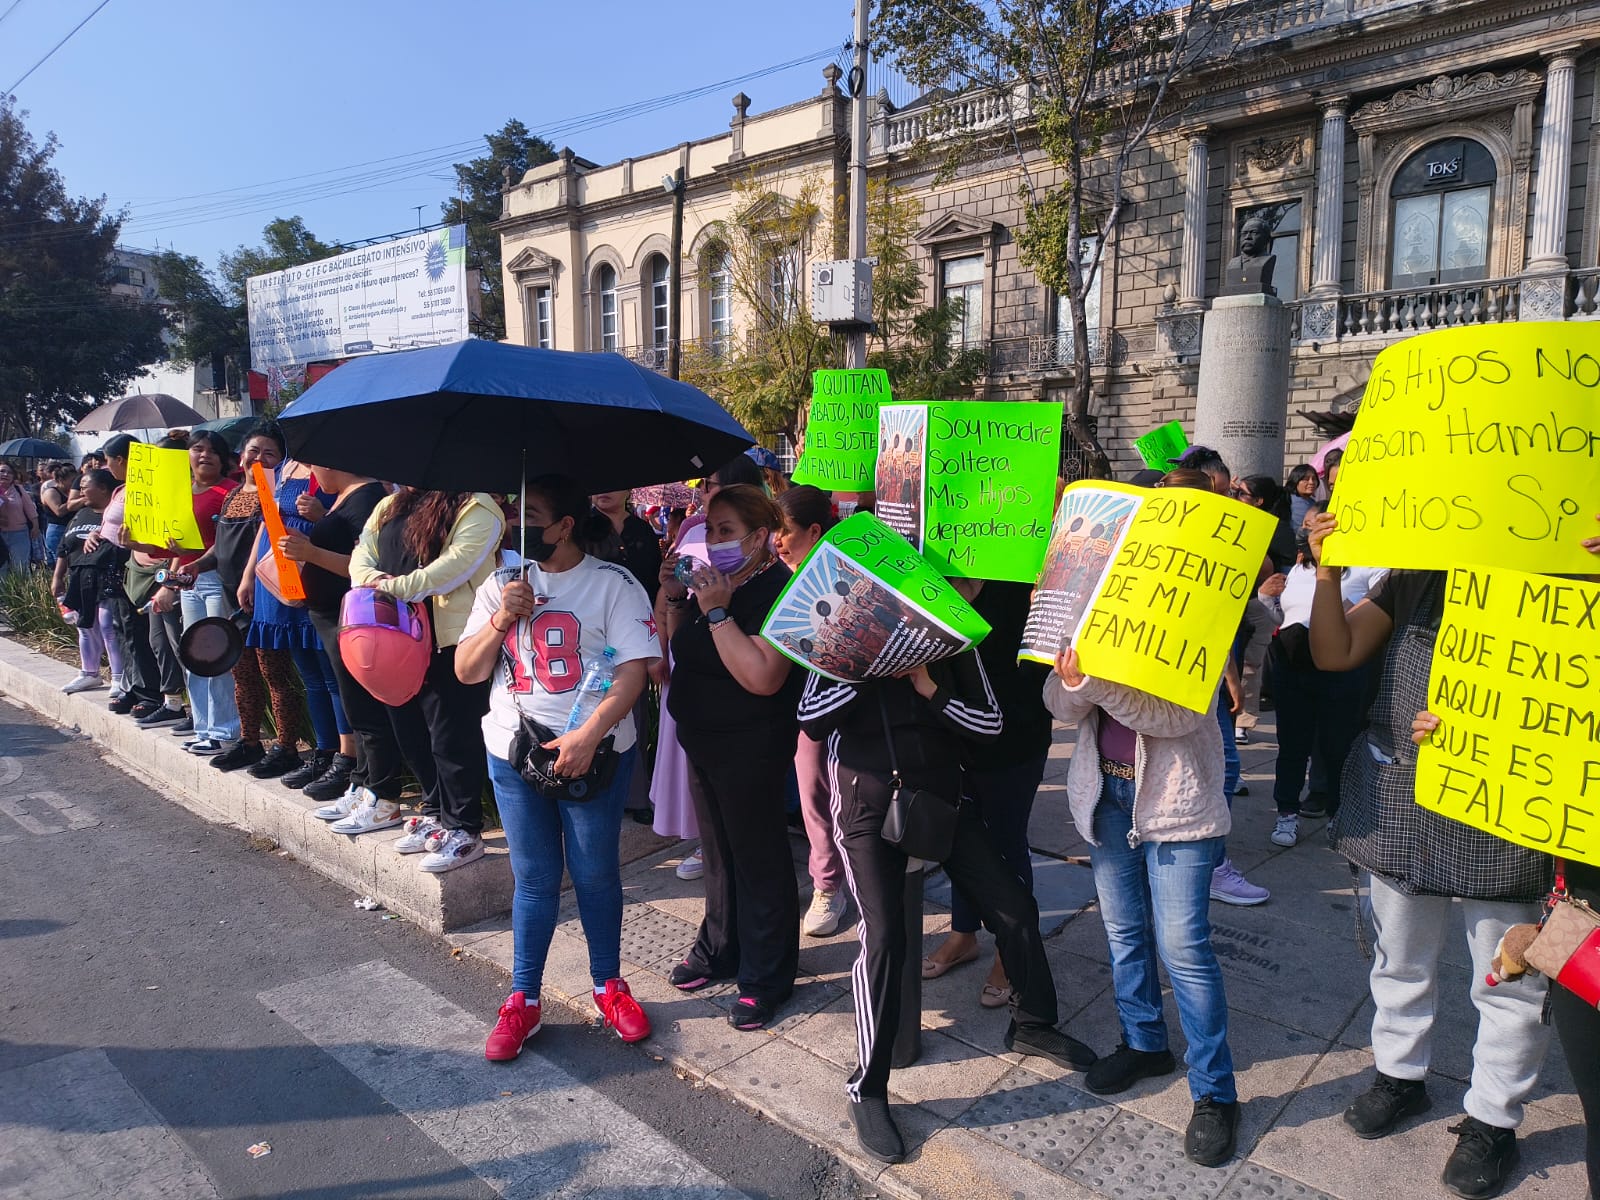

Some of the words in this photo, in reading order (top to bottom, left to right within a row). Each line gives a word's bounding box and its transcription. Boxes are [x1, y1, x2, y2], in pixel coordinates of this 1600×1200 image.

[260, 270, 302, 288] INSTITUTO
[328, 250, 382, 273] BACHILLERATO
[383, 240, 426, 260] INTENSIVO
[310, 327, 341, 338] Abogados
[823, 373, 883, 396] QUITAN
[932, 406, 982, 445] Soy
[987, 418, 1054, 446] madre
[812, 457, 870, 482] FAMILIA
[127, 513, 184, 541] MILIAS
[928, 517, 1016, 548] dependen
[1020, 520, 1047, 538] de
[1139, 497, 1200, 528] SOY
[1211, 512, 1248, 551] EL
[947, 546, 976, 567] Mi
[1117, 541, 1248, 600] SUSTENTO
[1102, 574, 1138, 604] DE
[1148, 582, 1191, 618] MI
[1448, 568, 1491, 610] EN
[502, 610, 584, 694] 18
[1084, 608, 1208, 682] FAMILIA
[1440, 624, 1496, 668] QUE
[1506, 640, 1600, 691] EXIS
[1434, 674, 1500, 721] AQUI
[1430, 720, 1490, 767] QUE
[1508, 744, 1554, 786] ES
[1437, 764, 1595, 854] FALSE
